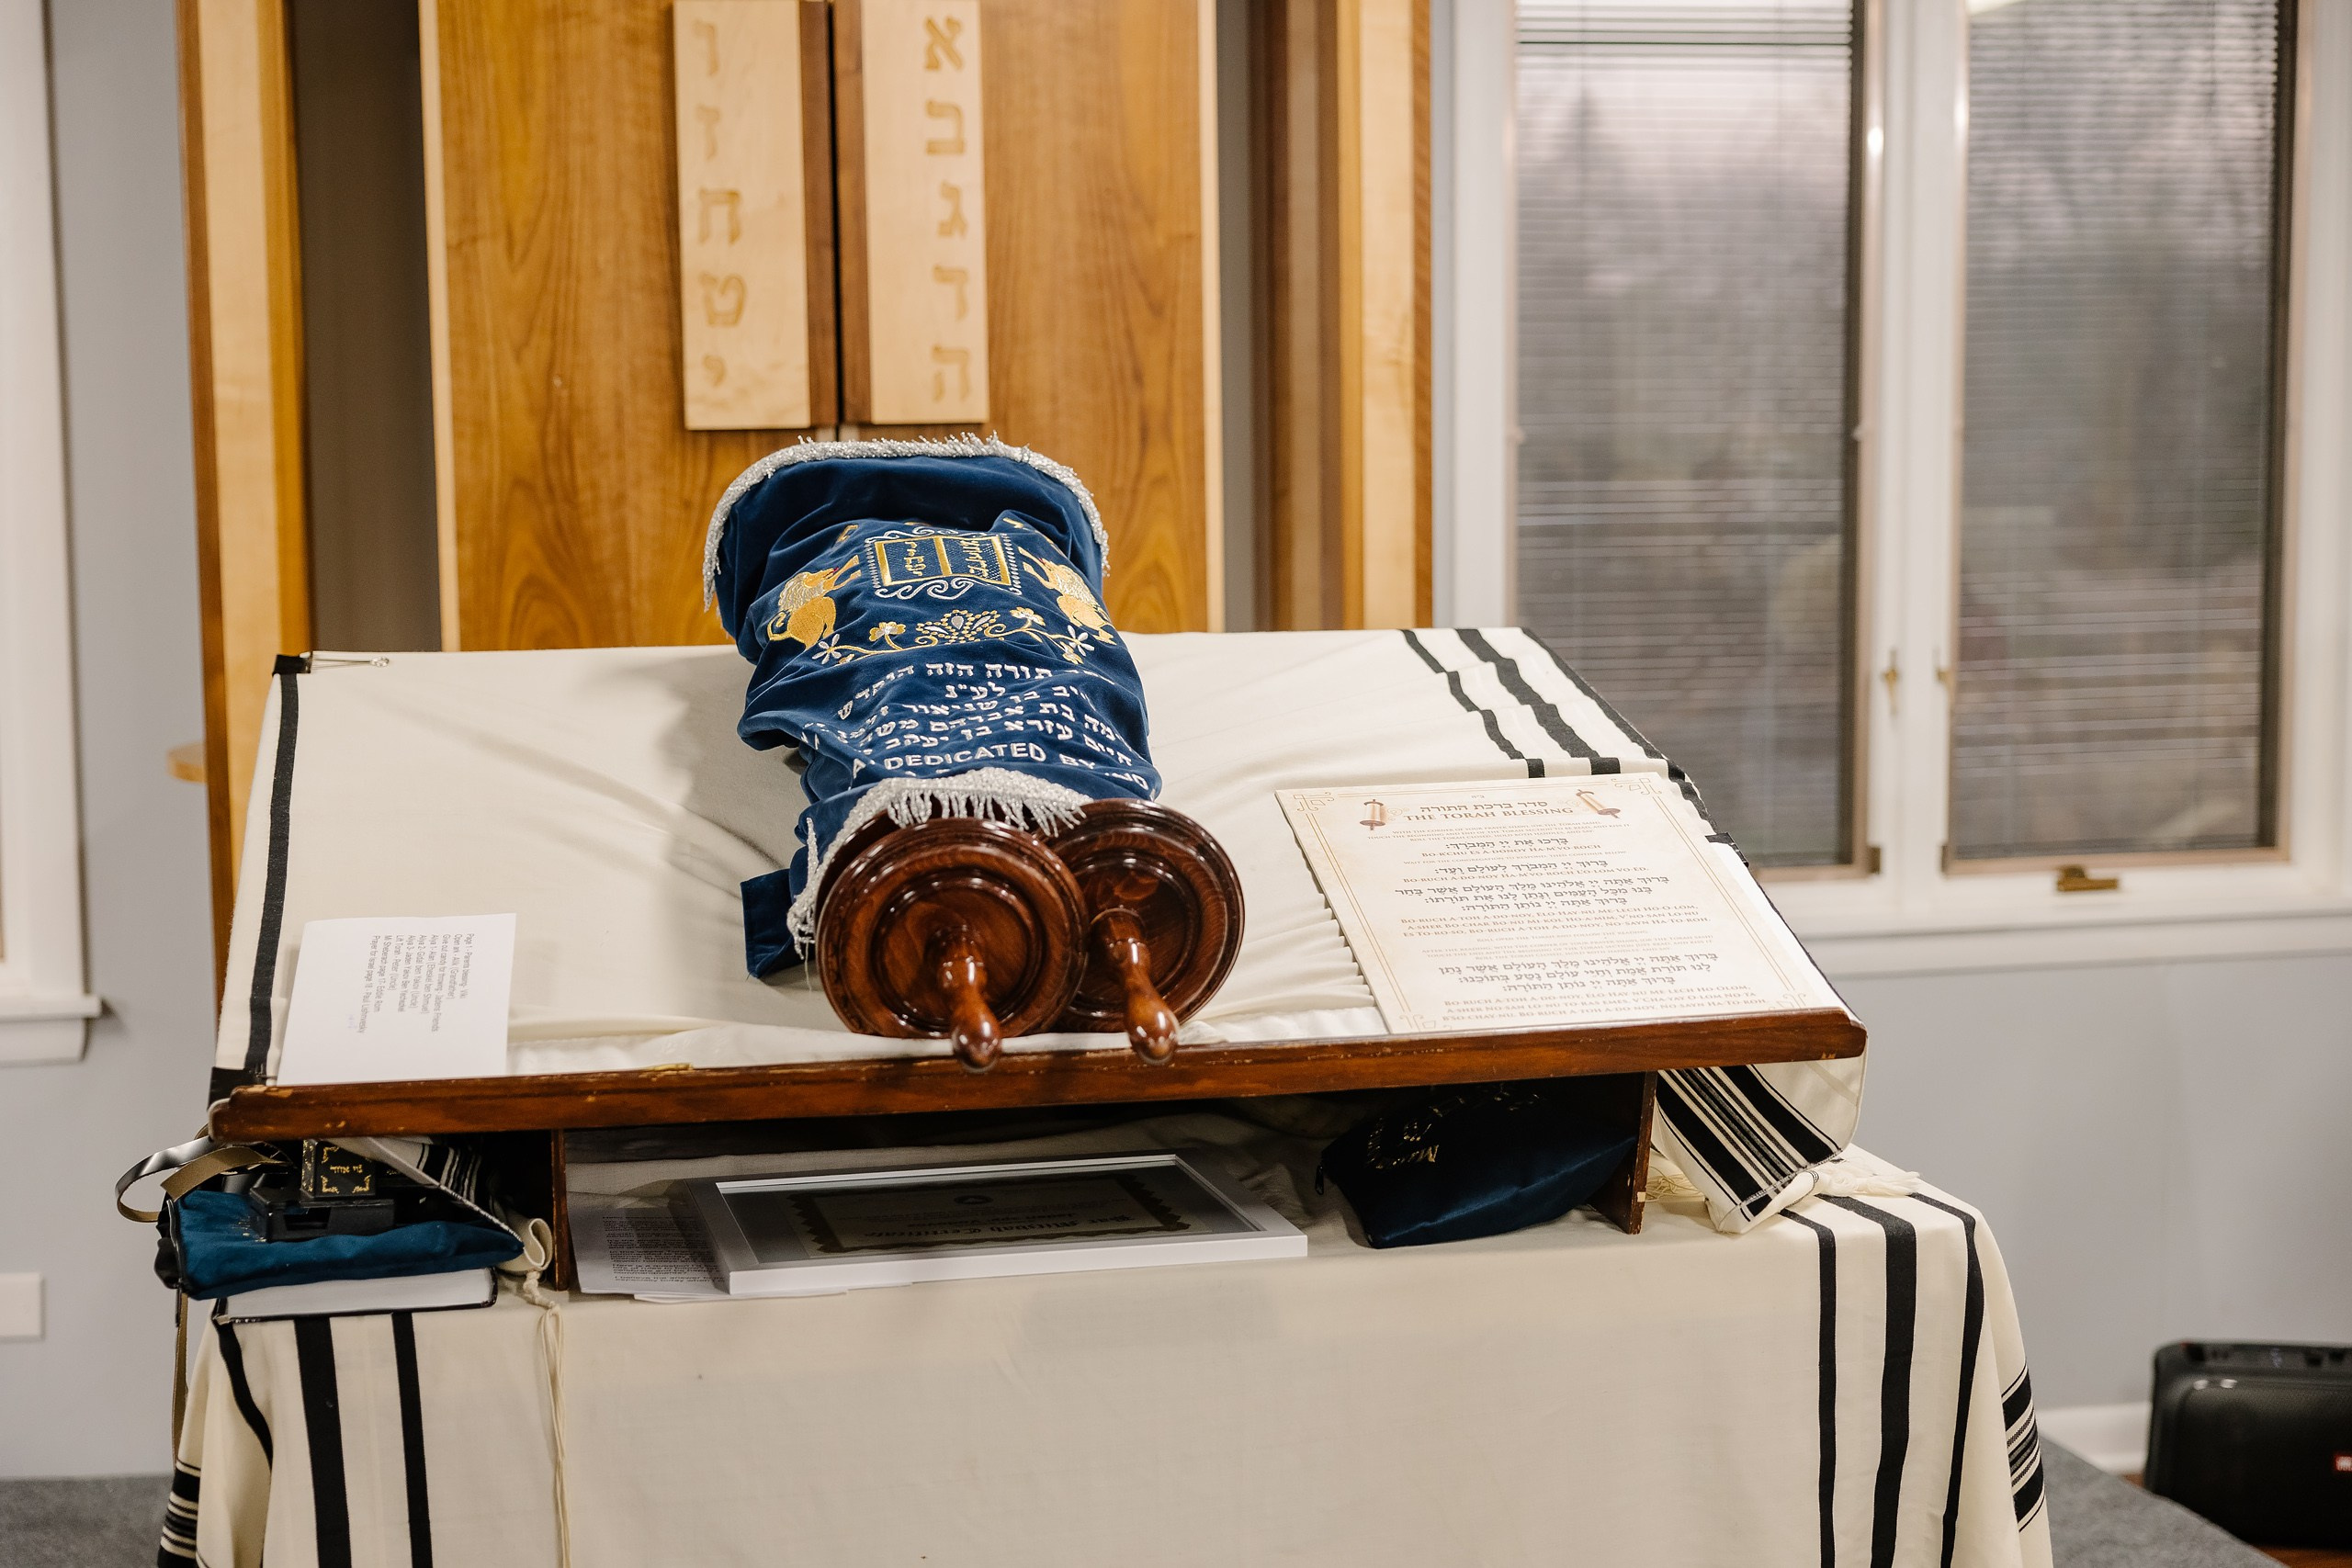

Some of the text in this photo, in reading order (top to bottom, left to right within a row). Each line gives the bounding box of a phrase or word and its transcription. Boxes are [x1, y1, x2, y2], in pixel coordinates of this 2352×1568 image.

[925, 662, 974, 677] הזה
[985, 663, 1053, 680] תורה
[1004, 719, 1073, 740] עזרא
[885, 733, 950, 750] יעקב
[884, 742, 1046, 770] DEDICATED
[1059, 753, 1096, 770] BY
[1441, 811, 1496, 819] TORAH
[1502, 807, 1573, 817] BLESSING
